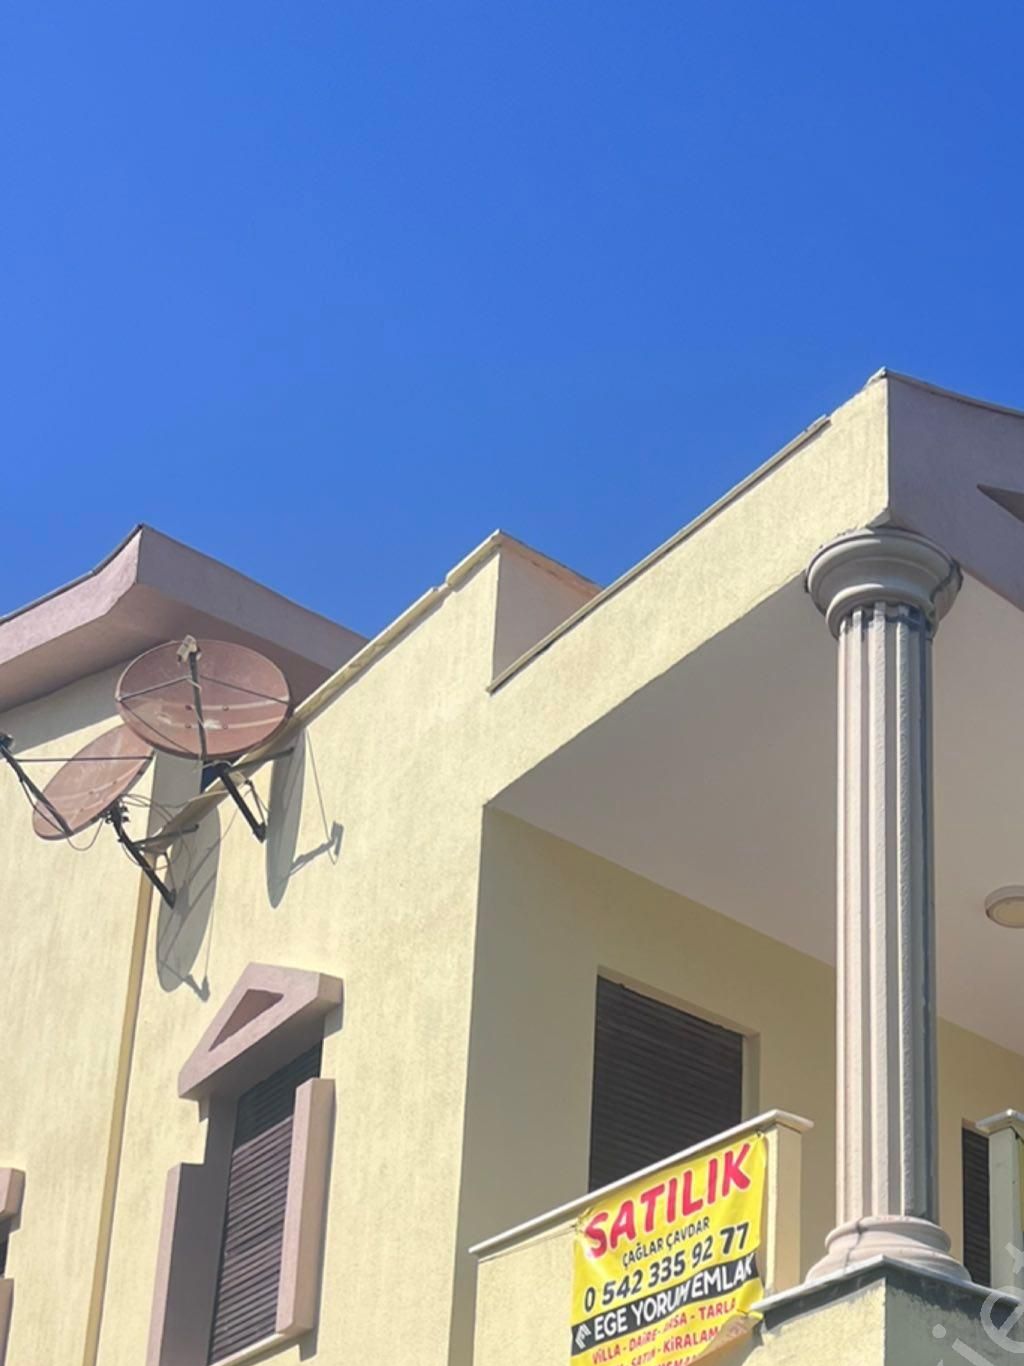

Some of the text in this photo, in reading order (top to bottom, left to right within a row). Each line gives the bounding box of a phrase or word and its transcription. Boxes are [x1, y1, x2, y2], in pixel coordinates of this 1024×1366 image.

[585, 1143, 751, 1259] SATILIK
[622, 1216, 710, 1268] ÇAĞLAR ÇAVDAR
[584, 1222, 750, 1312] 0 542 335 92 77
[594, 1308, 629, 1340] EGE
[691, 1252, 755, 1299] EMLAK
[592, 1343, 621, 1365] VİLLA
